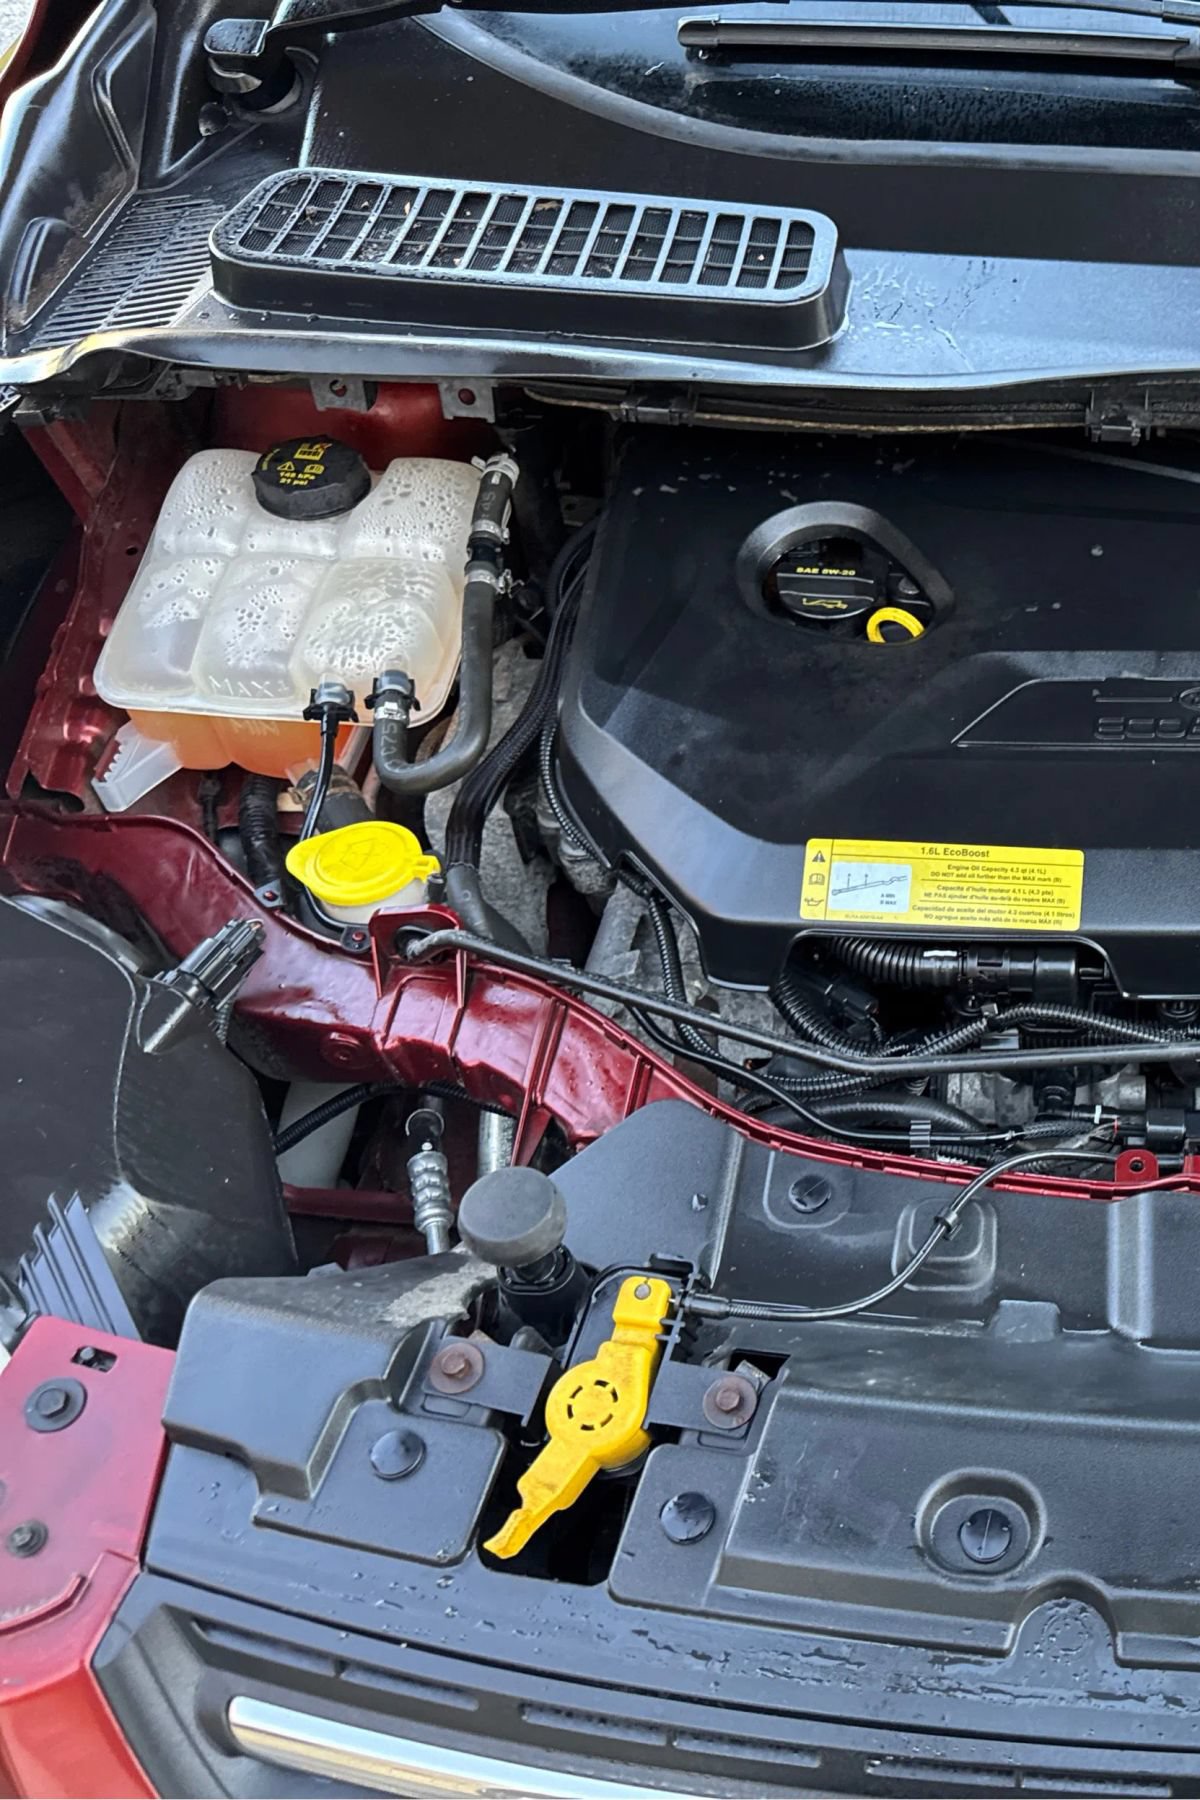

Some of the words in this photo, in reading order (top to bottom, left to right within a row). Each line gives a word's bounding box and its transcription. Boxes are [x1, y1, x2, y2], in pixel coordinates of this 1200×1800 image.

[796, 567, 820, 575] SAE
[208, 675, 275, 697] MAX
[920, 846, 940, 856] 1.6L
[942, 846, 989, 858] EcoBoost
[946, 863, 970, 871] Engine
[980, 865, 1008, 873] Capacity
